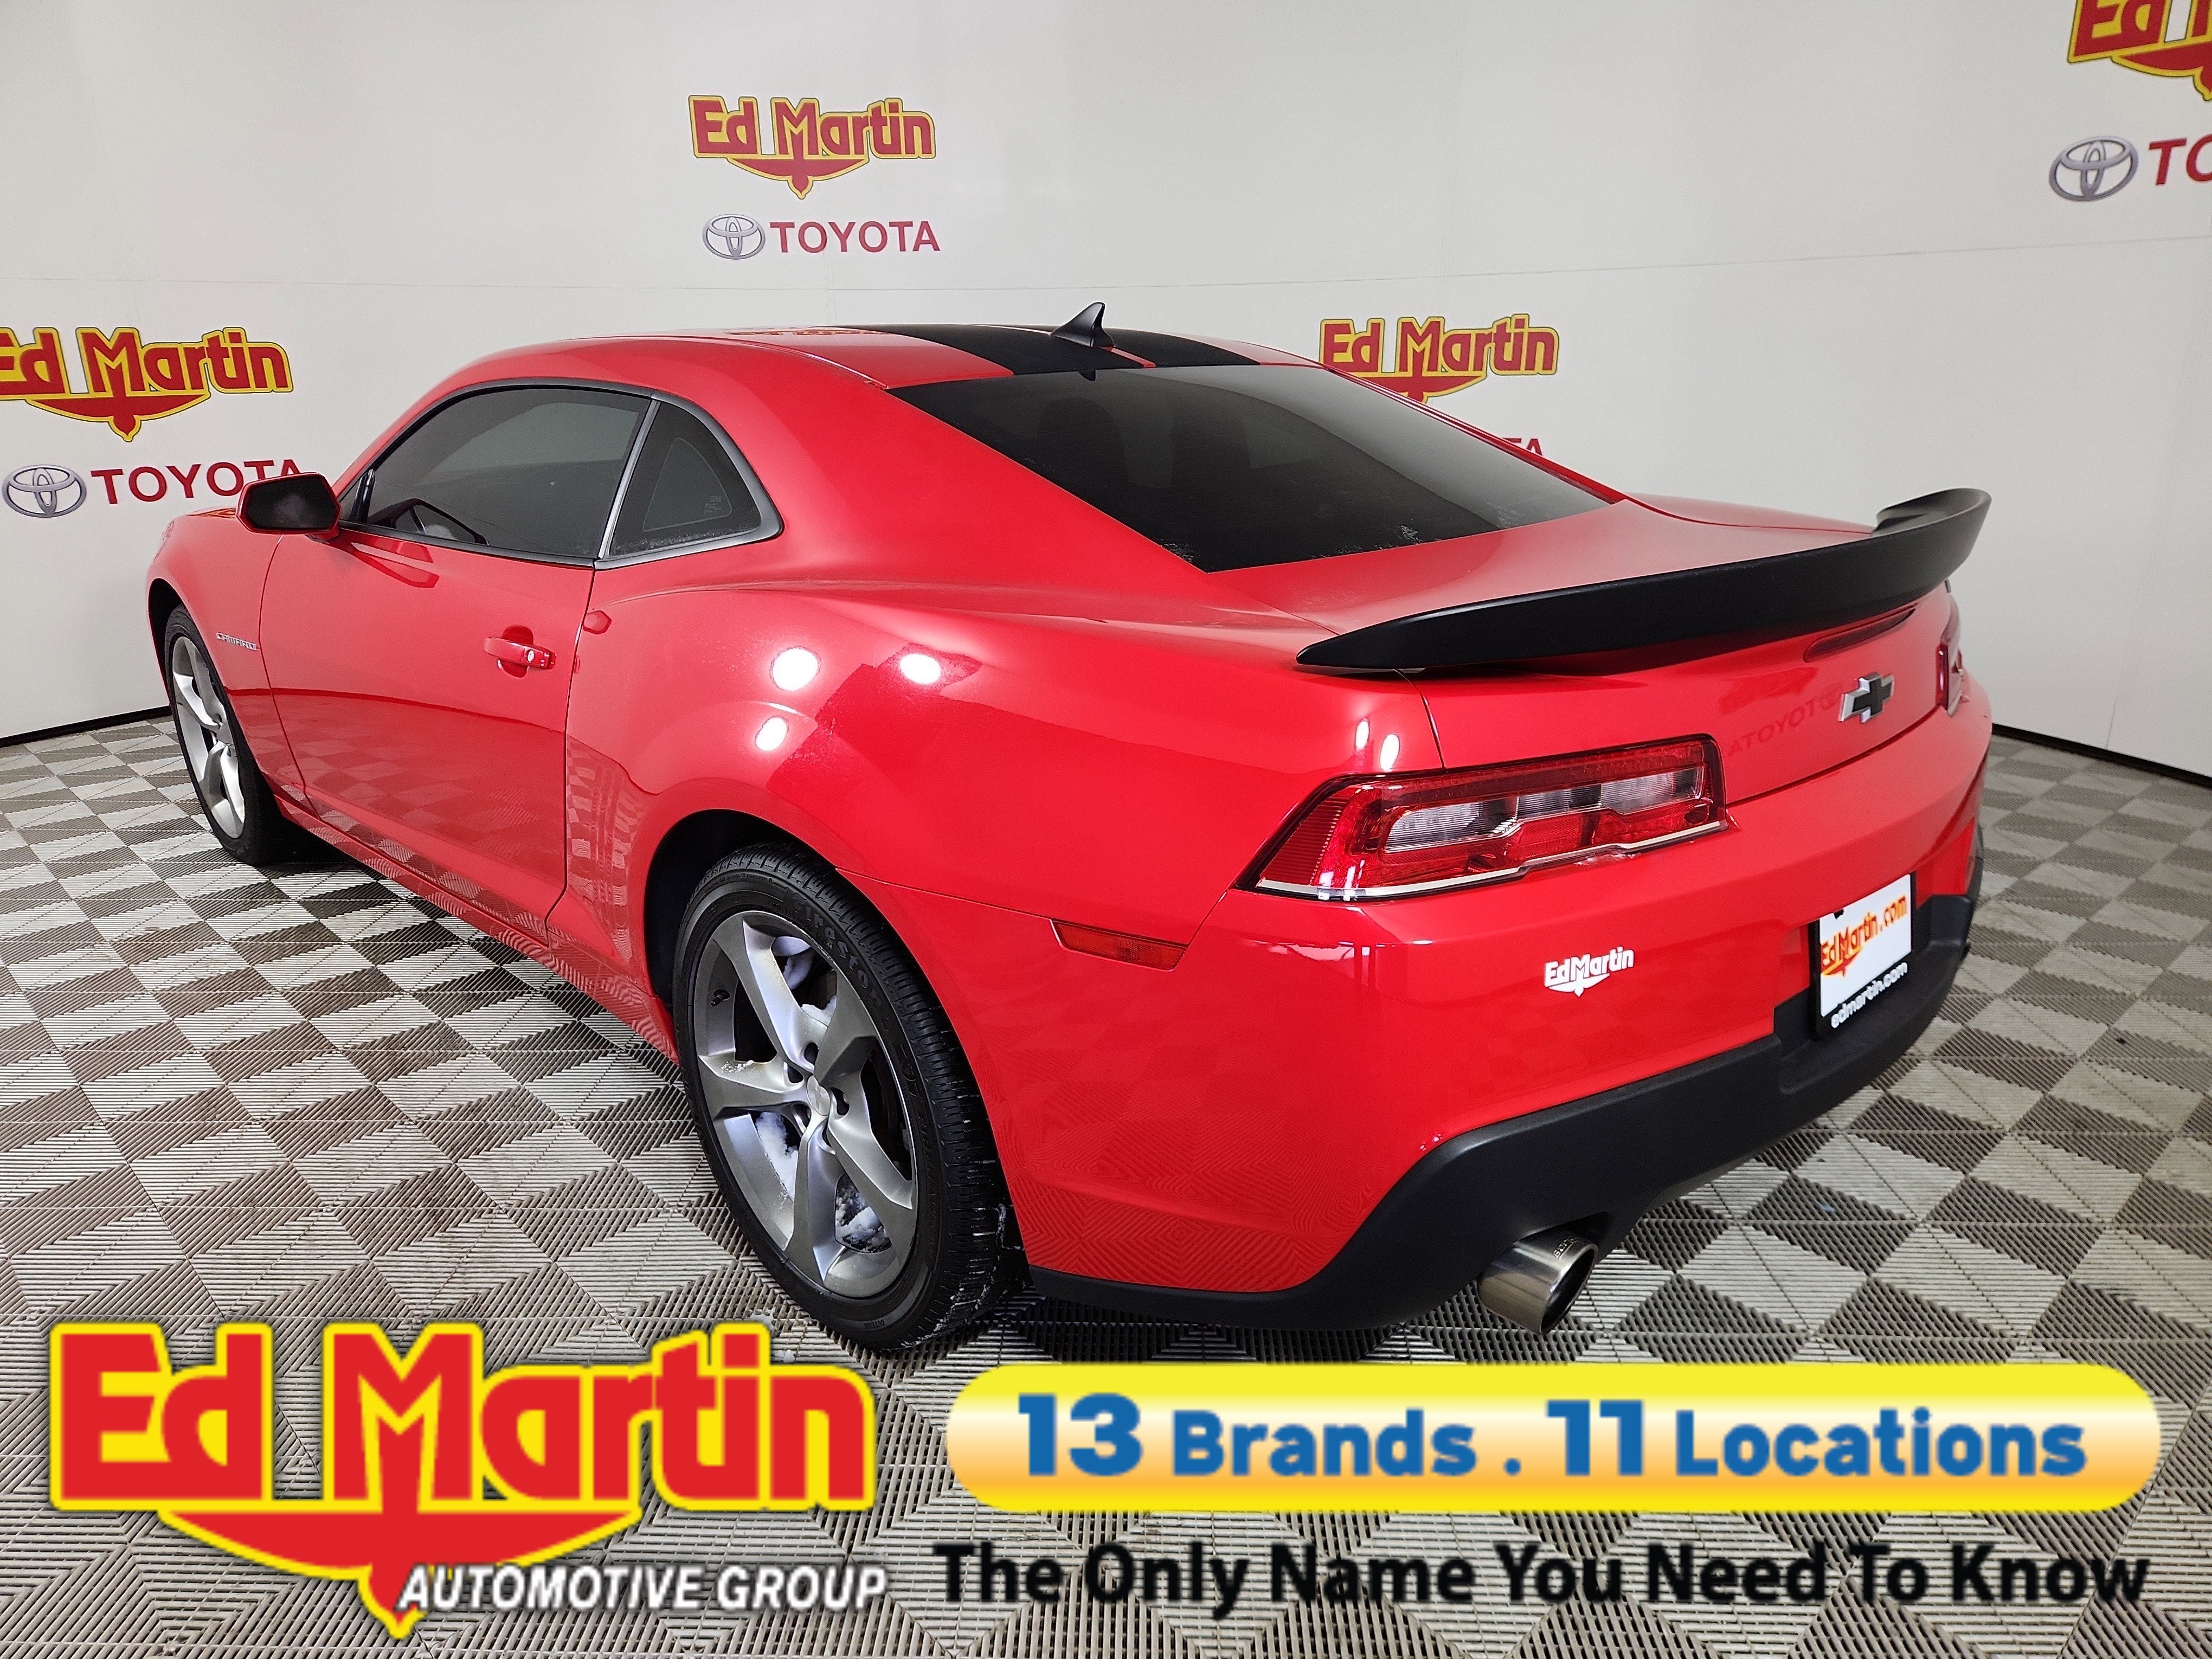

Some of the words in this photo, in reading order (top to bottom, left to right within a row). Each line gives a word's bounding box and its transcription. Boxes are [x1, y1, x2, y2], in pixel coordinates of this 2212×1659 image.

[689, 95, 761, 158] Ed
[770, 97, 936, 159] Martin
[770, 221, 941, 253] TOYOTA
[75, 327, 294, 394] Martin
[1320, 317, 1385, 374] Ed
[1397, 313, 1559, 376] Martin
[1831, 962, 1908, 1028] edmartin.com
